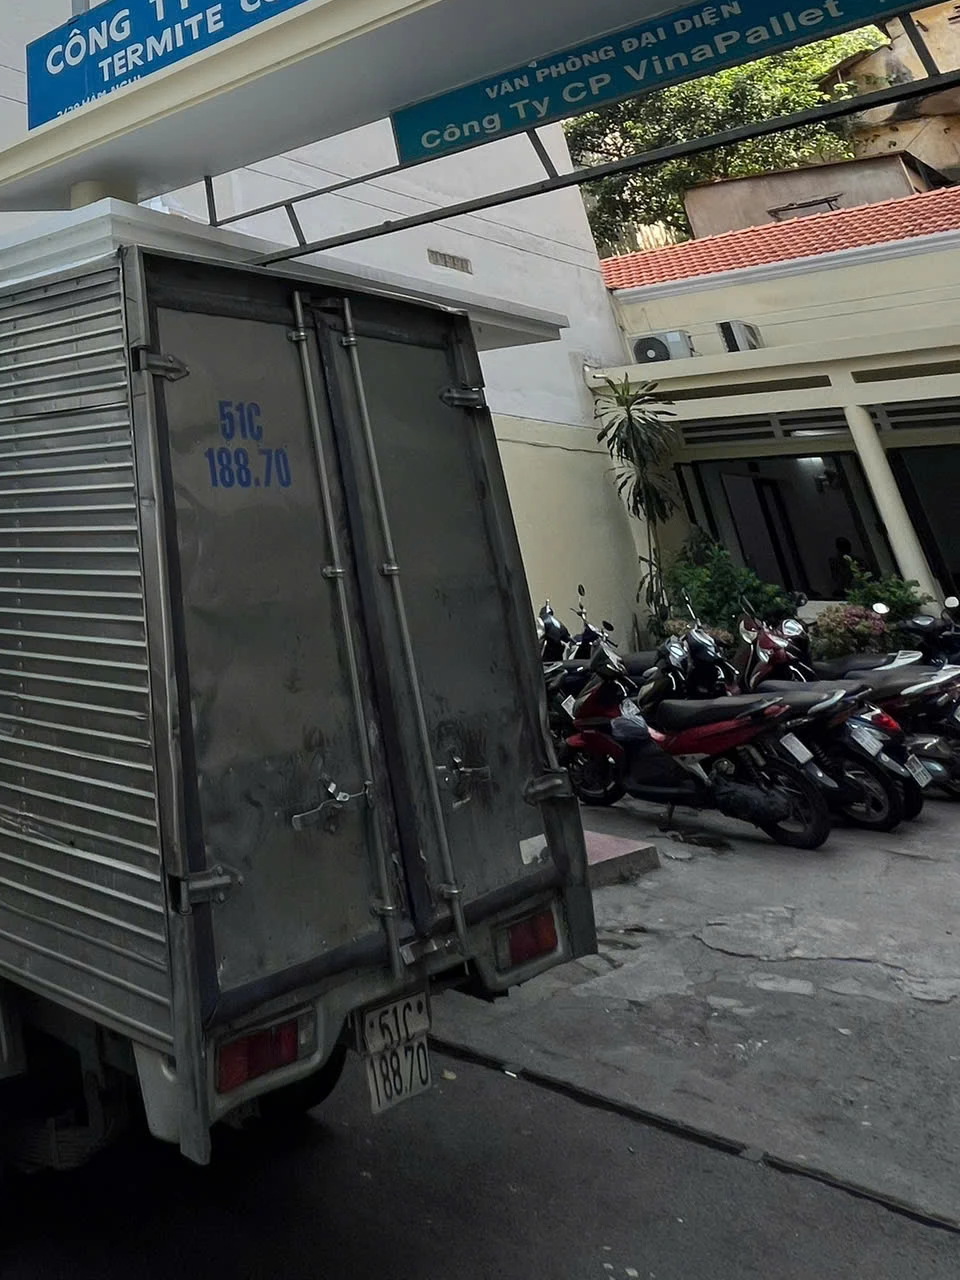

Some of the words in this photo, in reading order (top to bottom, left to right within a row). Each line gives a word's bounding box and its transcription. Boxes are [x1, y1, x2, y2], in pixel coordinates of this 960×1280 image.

[46, 9, 130, 75] CÔNG
[98, 3, 225, 81] TERMITE
[485, 74, 529, 99] VĂN
[536, 45, 616, 83] PHÒNG
[621, 26, 667, 52] ĐẠI
[674, 0, 742, 35] DIỆN
[421, 112, 502, 149] Công
[509, 95, 550, 119] Ty
[562, 73, 612, 104] CP
[218, 400, 263, 441] 51C
[204, 447, 292, 488] 188.70
[378, 1001, 416, 1048] 51C
[370, 1042, 429, 1107] 188.70
